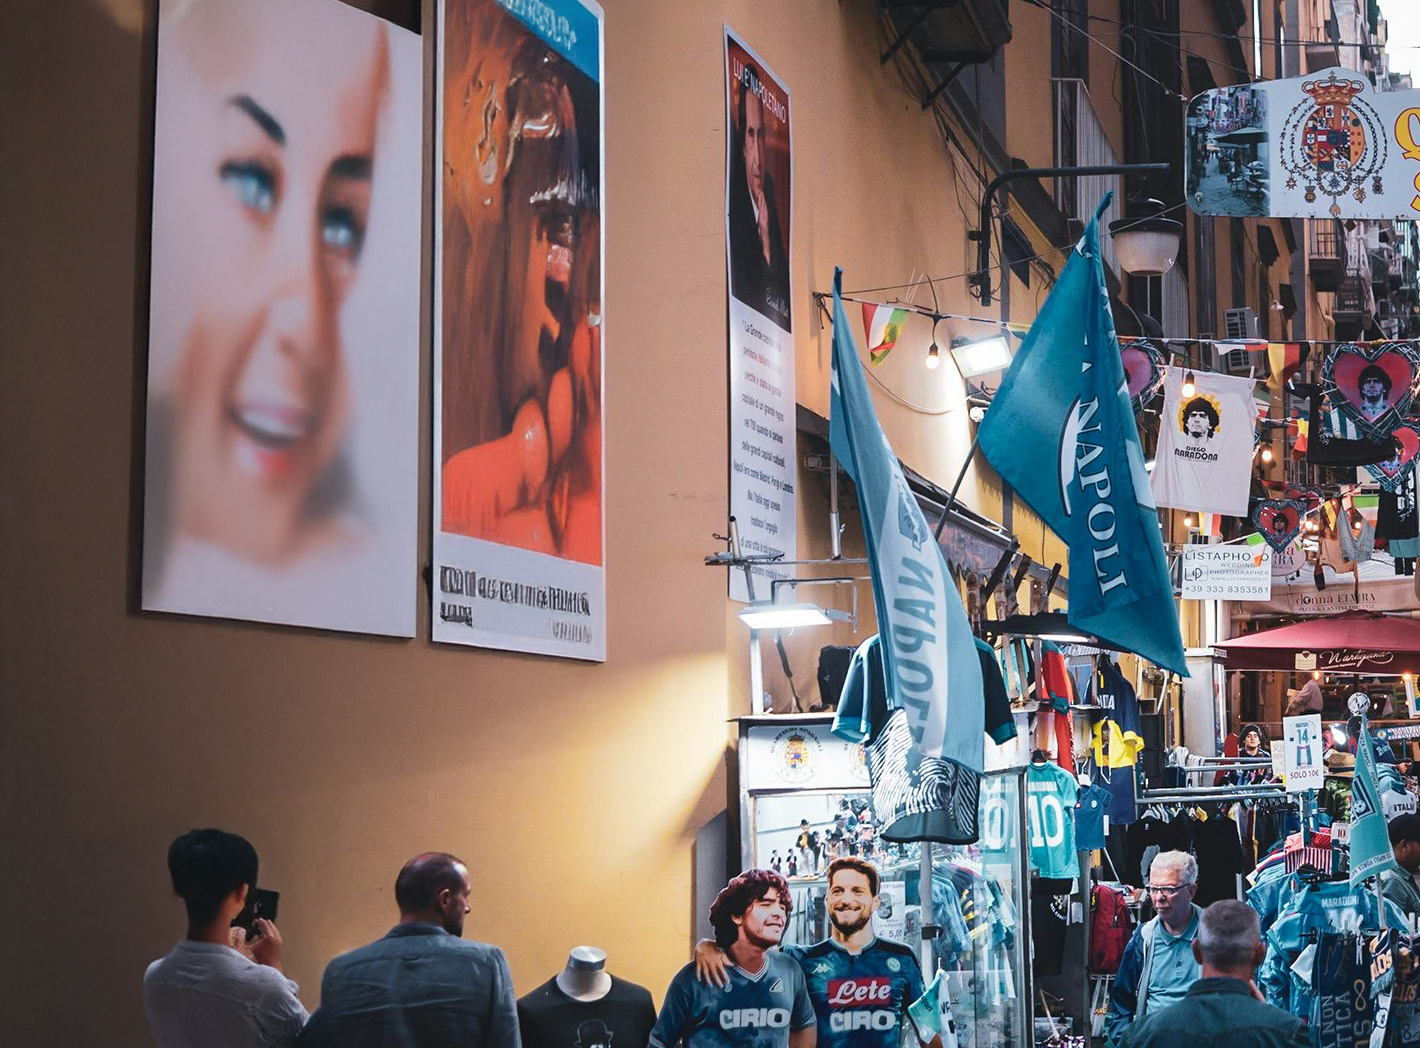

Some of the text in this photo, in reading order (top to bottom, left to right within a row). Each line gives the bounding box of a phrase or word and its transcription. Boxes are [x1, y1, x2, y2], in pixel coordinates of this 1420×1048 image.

[1174, 447, 1218, 461] MARADONA
[1075, 395, 1129, 597] NAPOLI
[1184, 551, 1270, 562] LISTAPHOO
[1227, 586, 1269, 594] 8353581
[1296, 593, 1376, 605] donna ELVRA
[1297, 729, 1309, 744] 14
[1290, 770, 1307, 779] SOLO
[1028, 794, 1064, 848] 10
[828, 980, 892, 1004] Lete
[719, 1008, 791, 1030] CIRIO
[829, 1009, 897, 1032] CIRO
[1321, 994, 1335, 1036] NON
